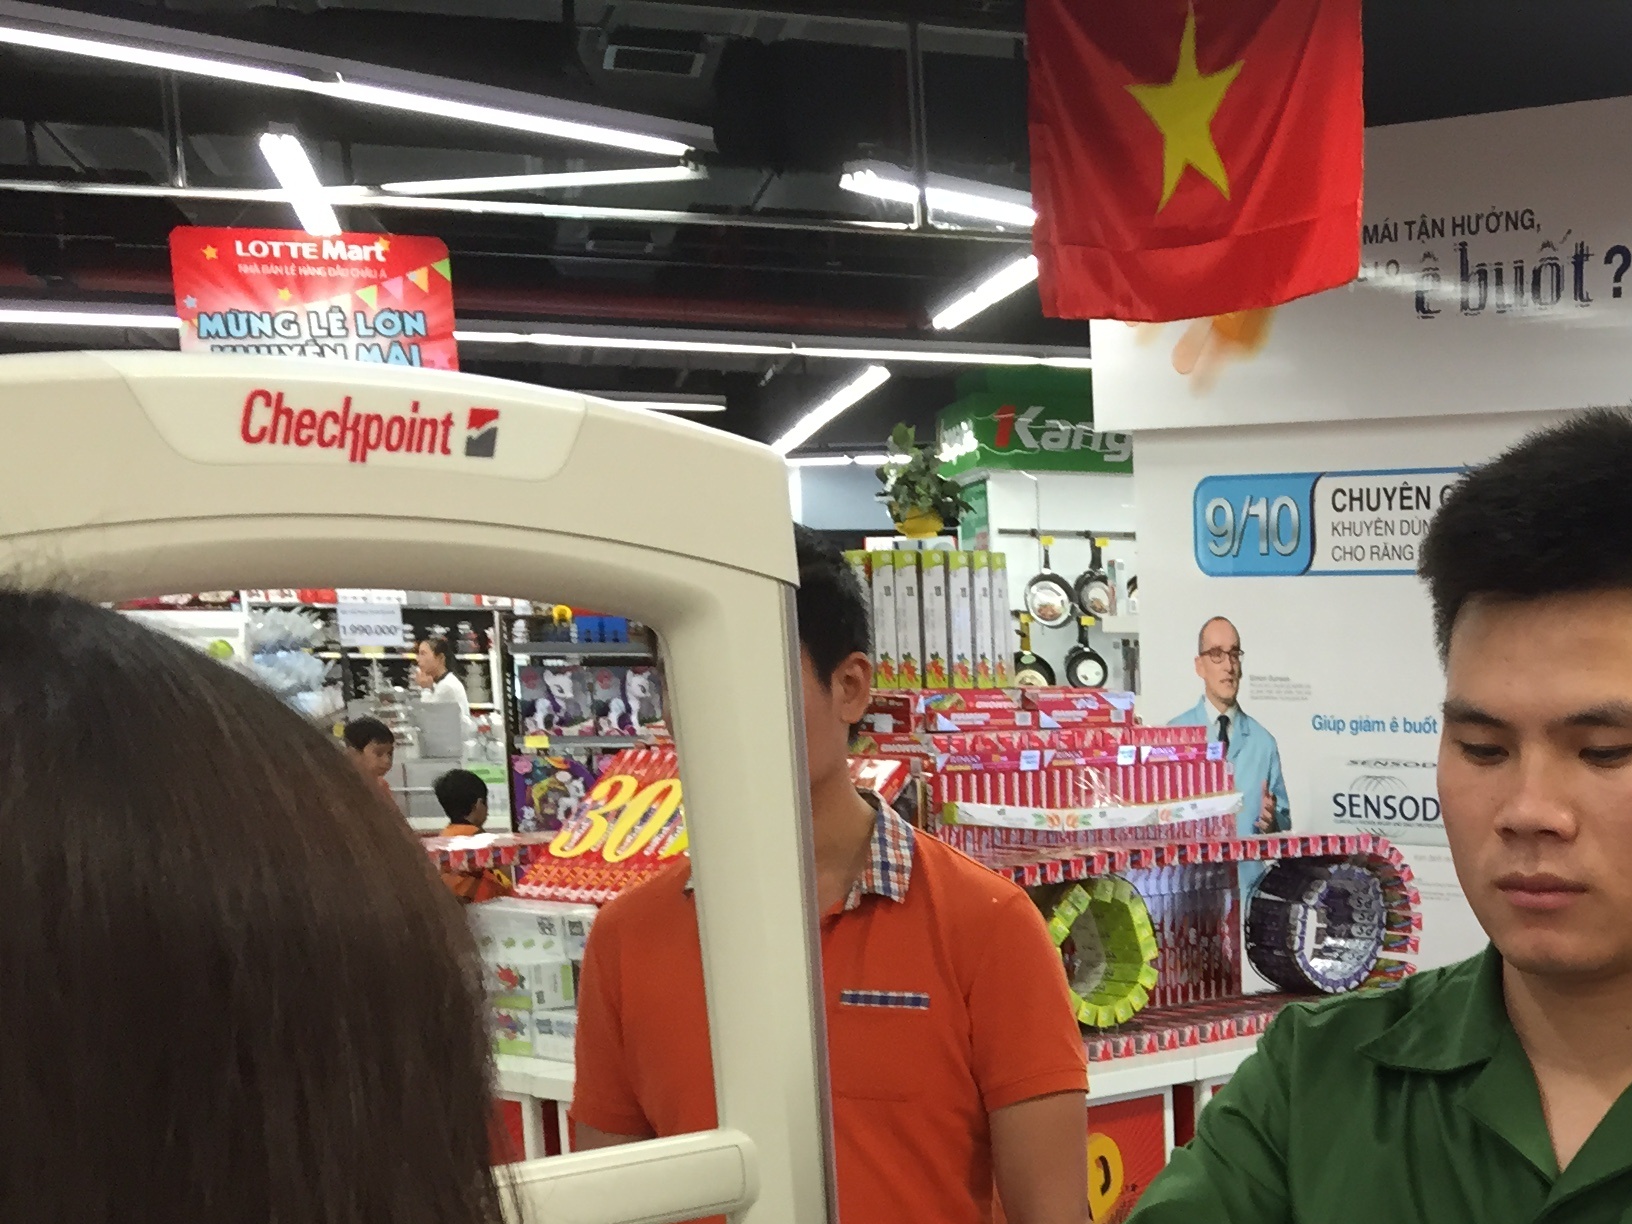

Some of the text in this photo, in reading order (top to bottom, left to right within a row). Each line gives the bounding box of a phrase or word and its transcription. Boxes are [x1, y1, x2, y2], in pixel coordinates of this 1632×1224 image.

[1362, 206, 1541, 245] MÁI TẬN HƯỞNG,
[235, 238, 387, 262] LOTTE Mart
[240, 388, 453, 463] Checkpoint
[1331, 481, 1431, 512] CHUYÊN
[1205, 495, 1300, 557] 9/10
[1331, 517, 1395, 537] KHUYÊN
[1331, 542, 1414, 562] CHO RĂNG
[1311, 714, 1438, 735] Giúp giảm ê buốt
[549, 774, 684, 861] 30
[1332, 792, 1441, 822] SENSOD
